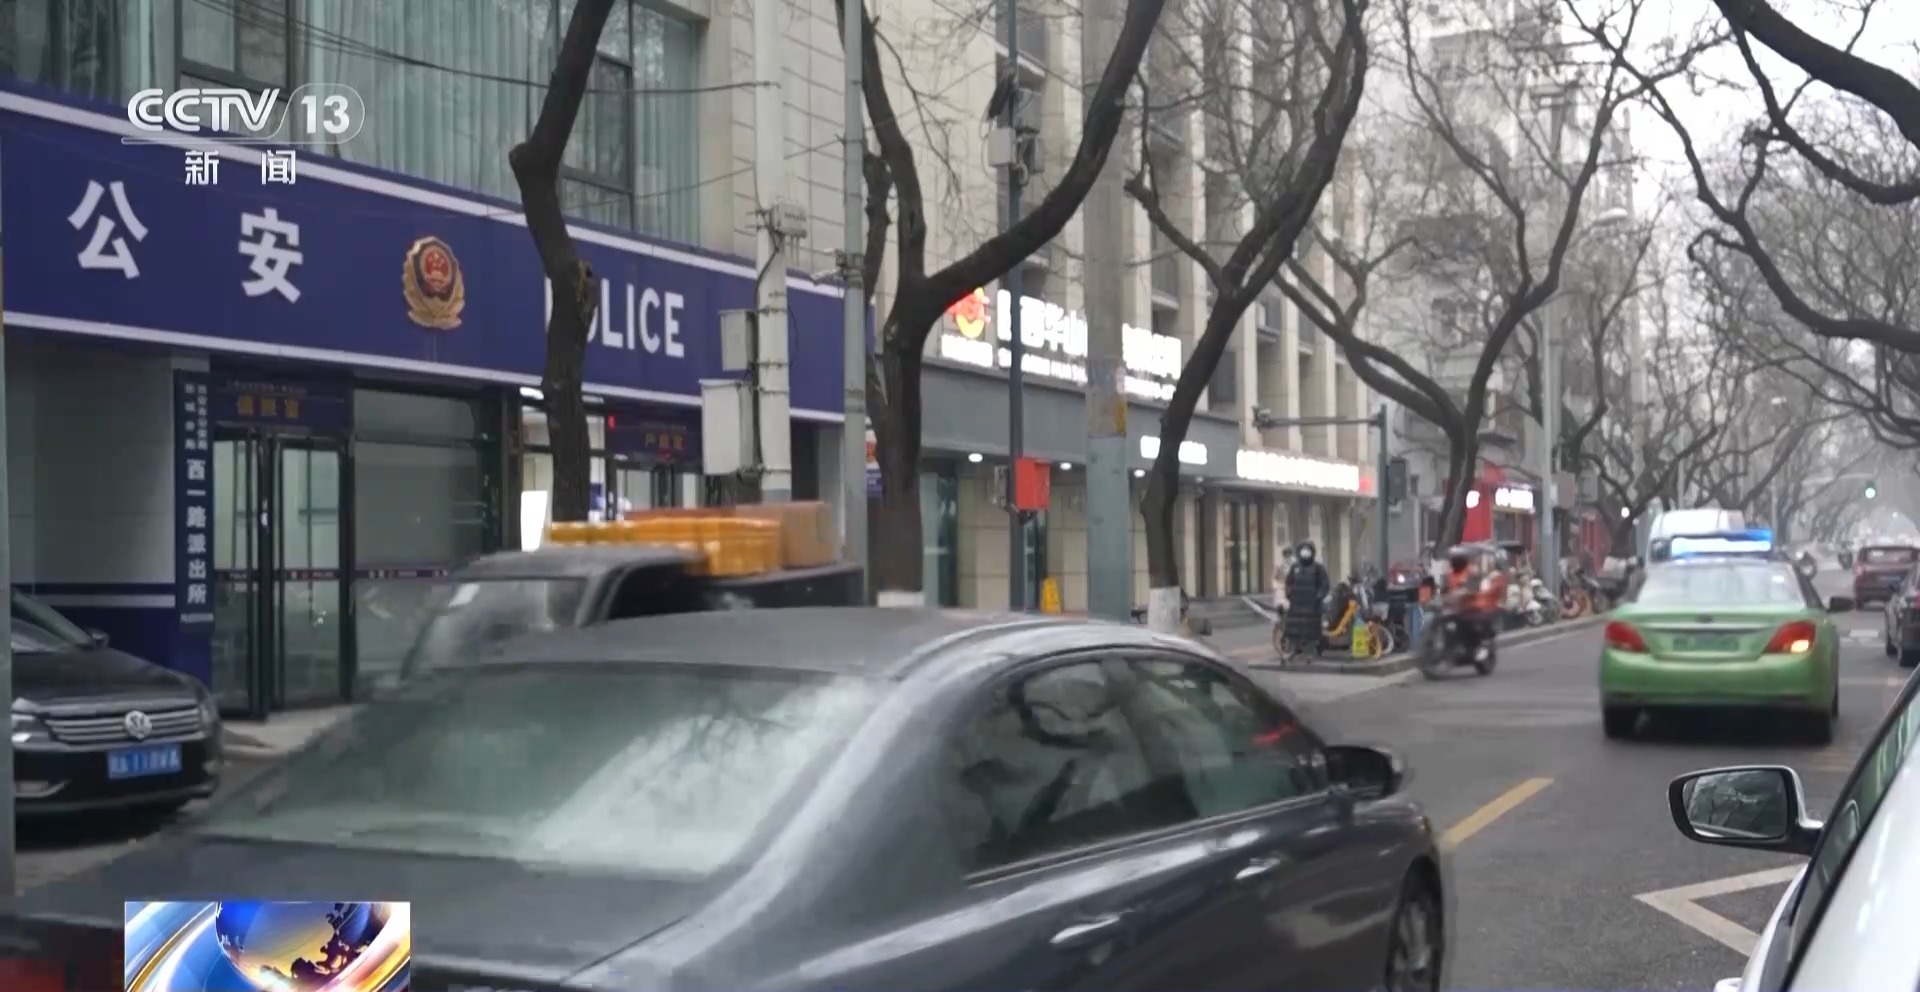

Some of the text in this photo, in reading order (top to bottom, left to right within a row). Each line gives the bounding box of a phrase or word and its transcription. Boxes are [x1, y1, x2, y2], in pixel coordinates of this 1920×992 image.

[67, 179, 303, 304] 公安
[544, 275, 685, 358] LICE
[186, 458, 207, 604] 西一路派出所
